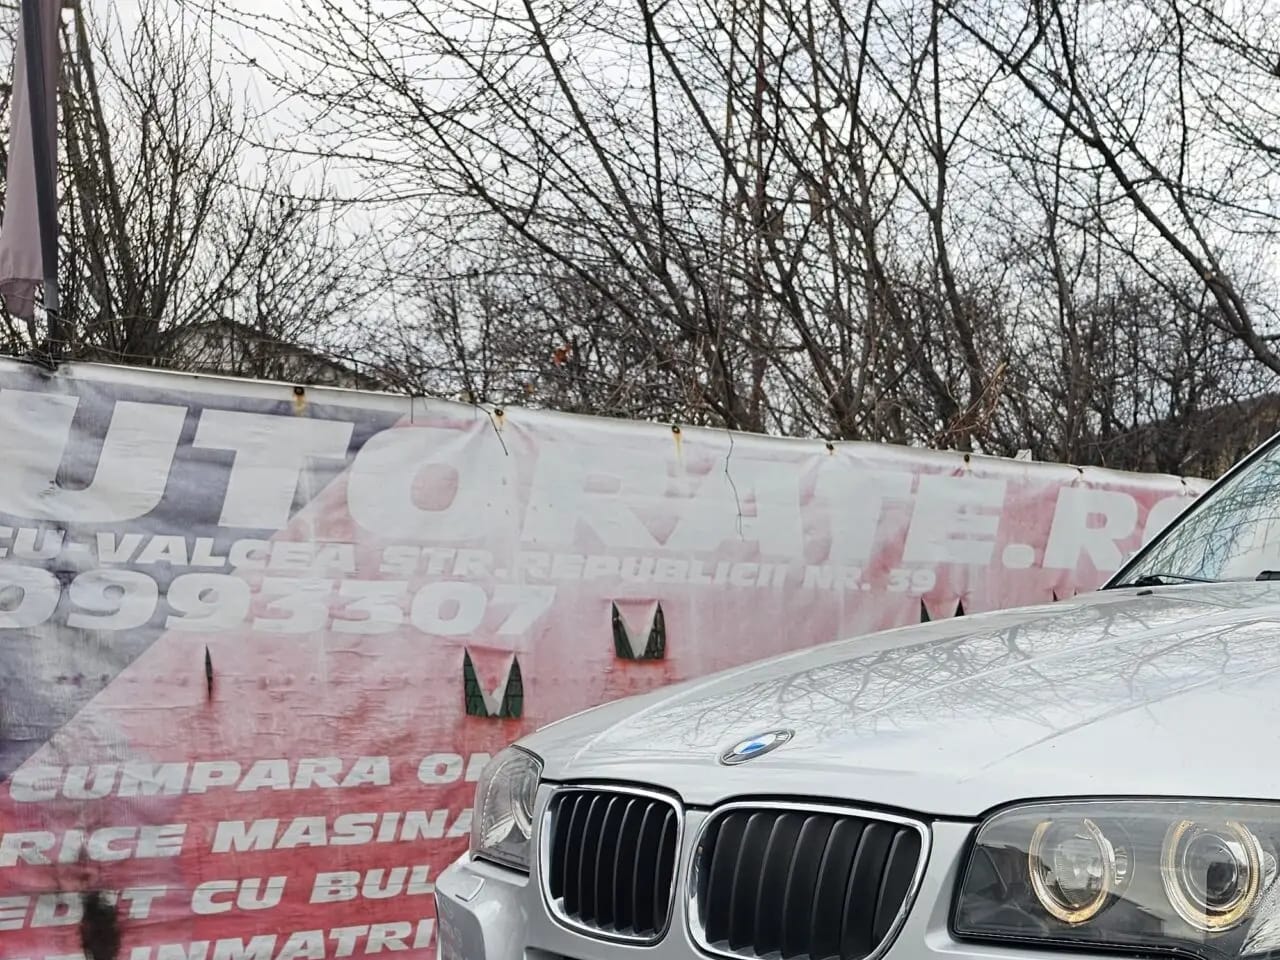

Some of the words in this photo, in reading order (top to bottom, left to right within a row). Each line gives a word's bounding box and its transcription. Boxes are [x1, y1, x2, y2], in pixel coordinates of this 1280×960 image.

[887, 569, 936, 592] 39
[9, 755, 391, 802] CUMPARA
[0, 823, 187, 866] RICE
[191, 876, 287, 914] CU
